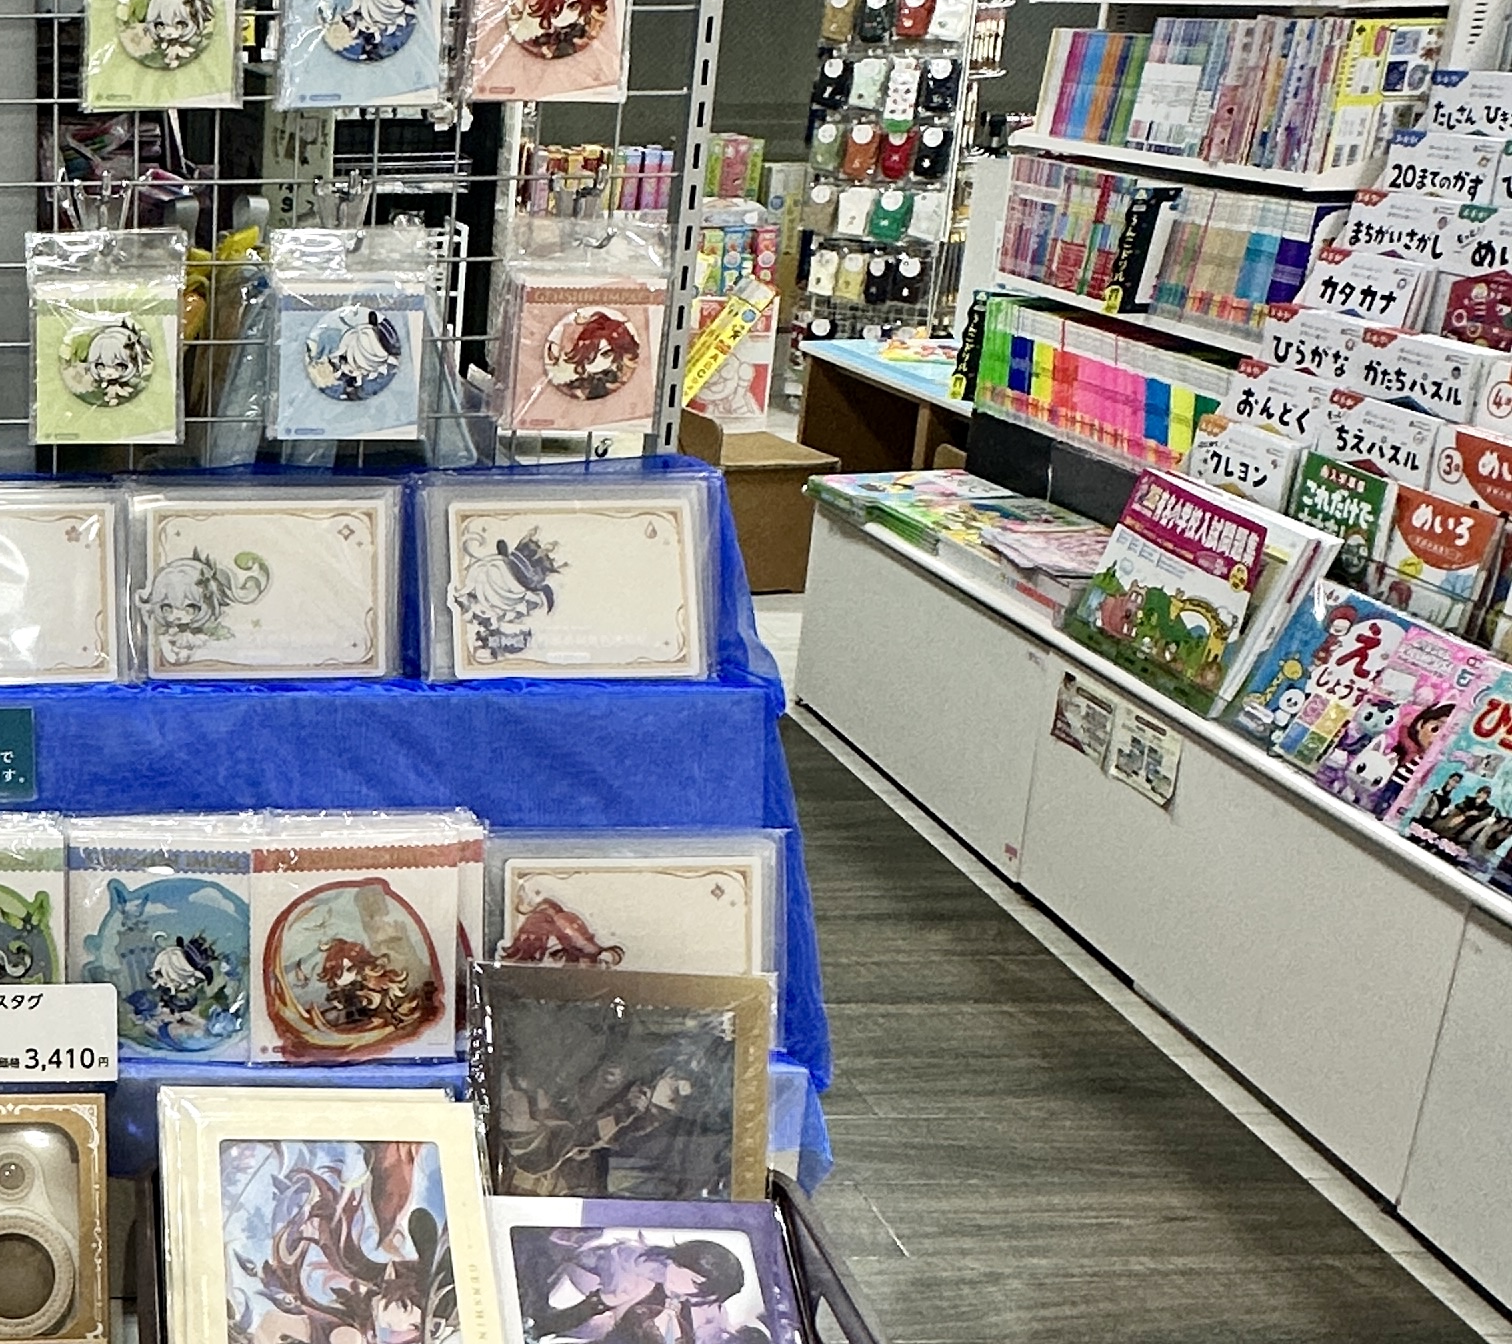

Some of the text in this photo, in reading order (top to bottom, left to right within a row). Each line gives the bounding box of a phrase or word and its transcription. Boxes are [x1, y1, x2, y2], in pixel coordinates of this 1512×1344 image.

[1319, 274, 1398, 316] カタカナ
[1272, 334, 1351, 379] ひらがな
[1209, 449, 1269, 489] クレヨン
[1410, 502, 1476, 547] めいろ
[23, 1047, 110, 1073] 3,410円
[468, 1263, 488, 1341] GENSHIN
